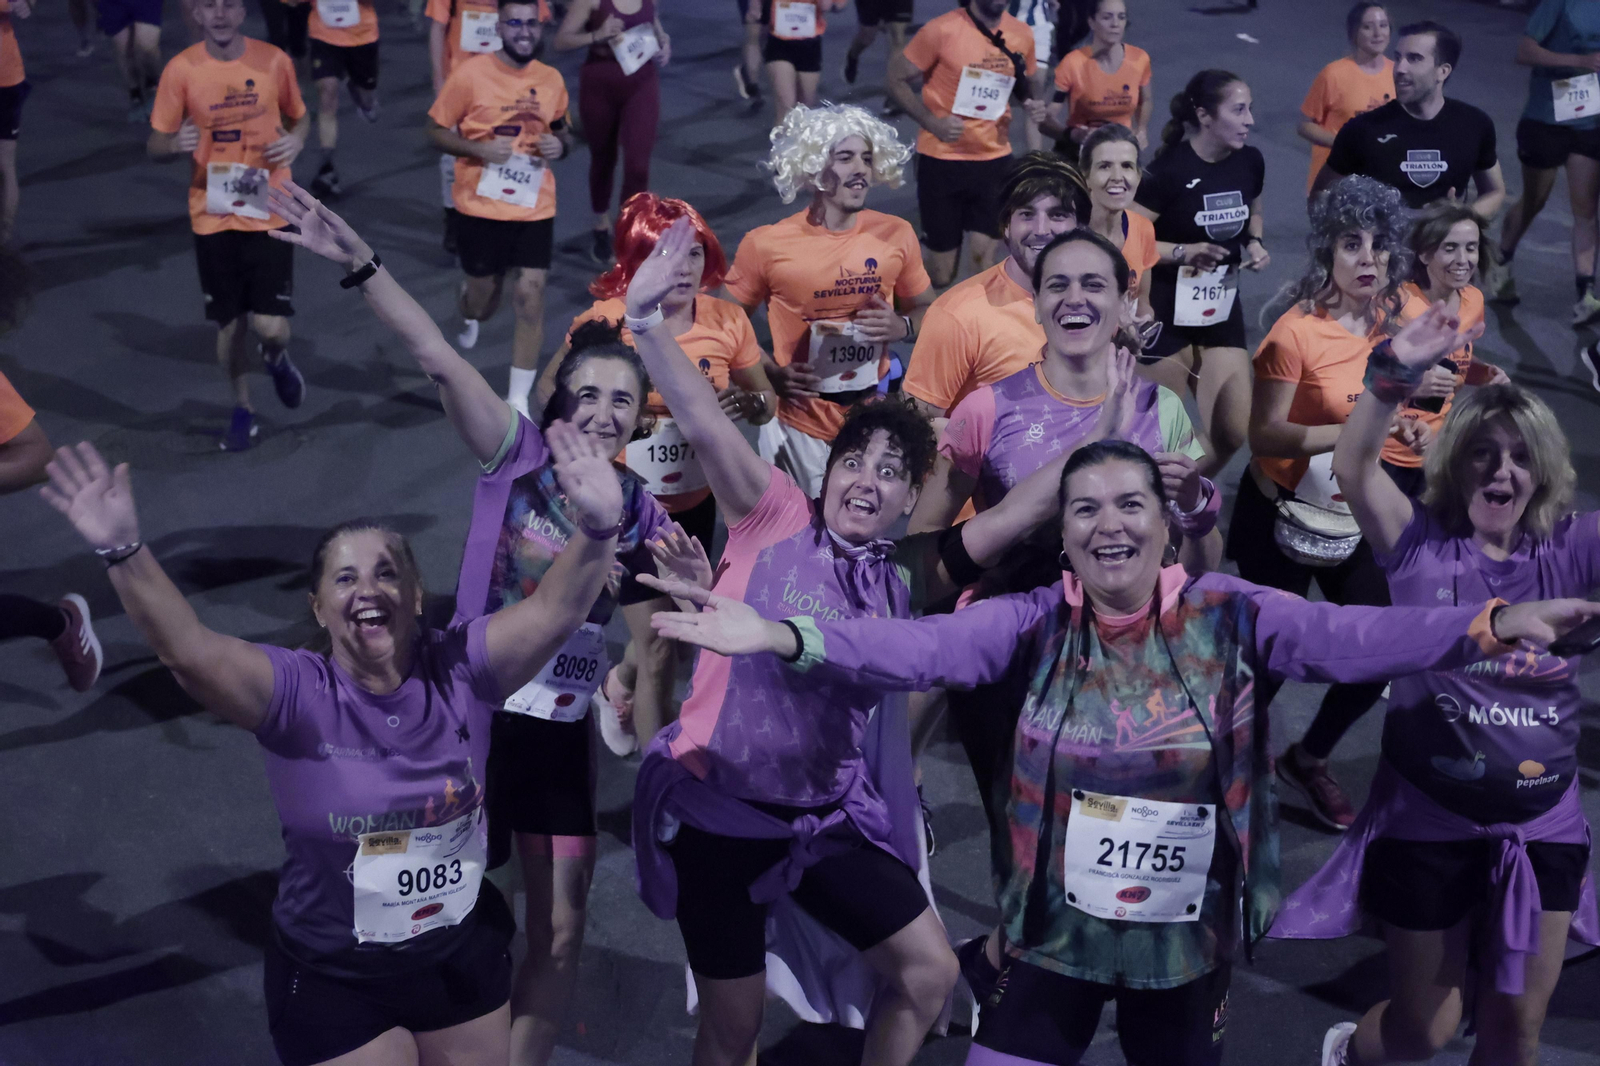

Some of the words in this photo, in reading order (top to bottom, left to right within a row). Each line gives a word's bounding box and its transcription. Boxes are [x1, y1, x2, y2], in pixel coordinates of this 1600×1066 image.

[971, 85, 1000, 101] 11549
[1567, 89, 1590, 102] 7781
[498, 167, 532, 184] 15424
[1215, 198, 1234, 207] CLUB
[1202, 208, 1246, 222] TRIATLÓN
[835, 276, 882, 287] NOCTURNA
[813, 287, 856, 299] SEVILLA
[858, 284, 881, 295] KH7
[1192, 285, 1227, 301] 21671
[830, 345, 875, 364] 13900
[553, 653, 598, 682] 8098
[1468, 702, 1559, 727] MÓVIL-5
[328, 810, 417, 835] WOMAN
[1096, 837, 1187, 872] 21755
[397, 859, 463, 897] 9083
[1088, 868, 1120, 879] FRANCISCA
[401, 897, 428, 906] MONTAÑA
[1119, 890, 1145, 901] KH7
